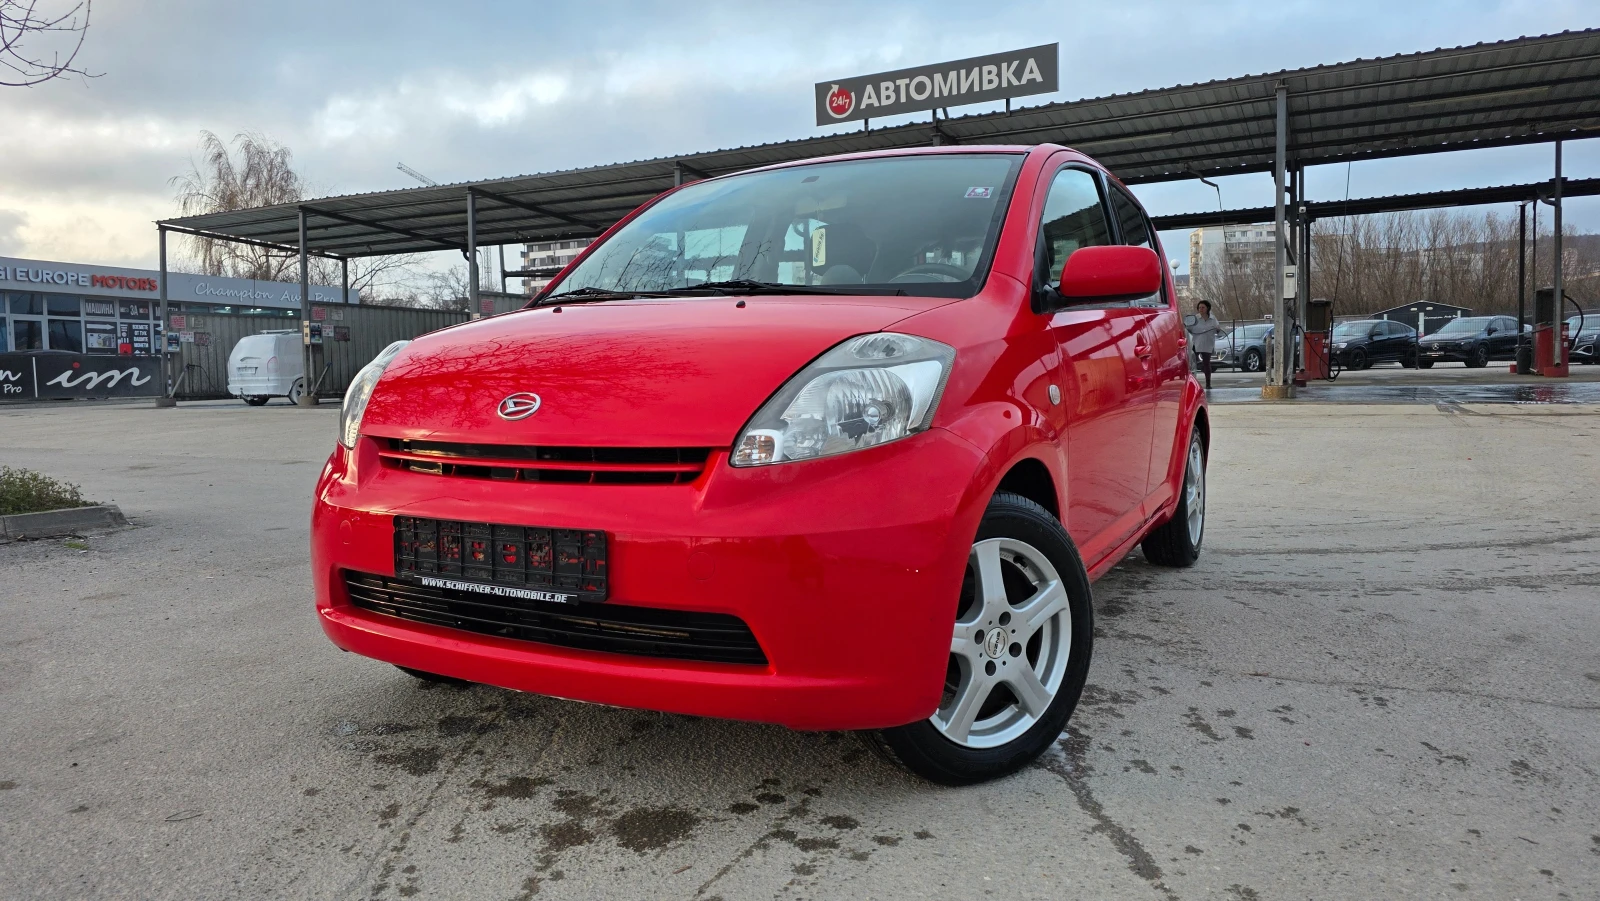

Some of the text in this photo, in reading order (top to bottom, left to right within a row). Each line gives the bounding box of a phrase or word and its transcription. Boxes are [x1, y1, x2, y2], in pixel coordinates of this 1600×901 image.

[832, 57, 1044, 110] 24/7 АВТОМИВКА
[16, 267, 90, 286] EUROPE
[195, 282, 274, 302] Champion
[86, 302, 114, 315] МАШИНА
[3, 383, 23, 394] Pro
[421, 577, 568, 604] WWW.SCHIFFNER-AUTOMOBILE.DE
